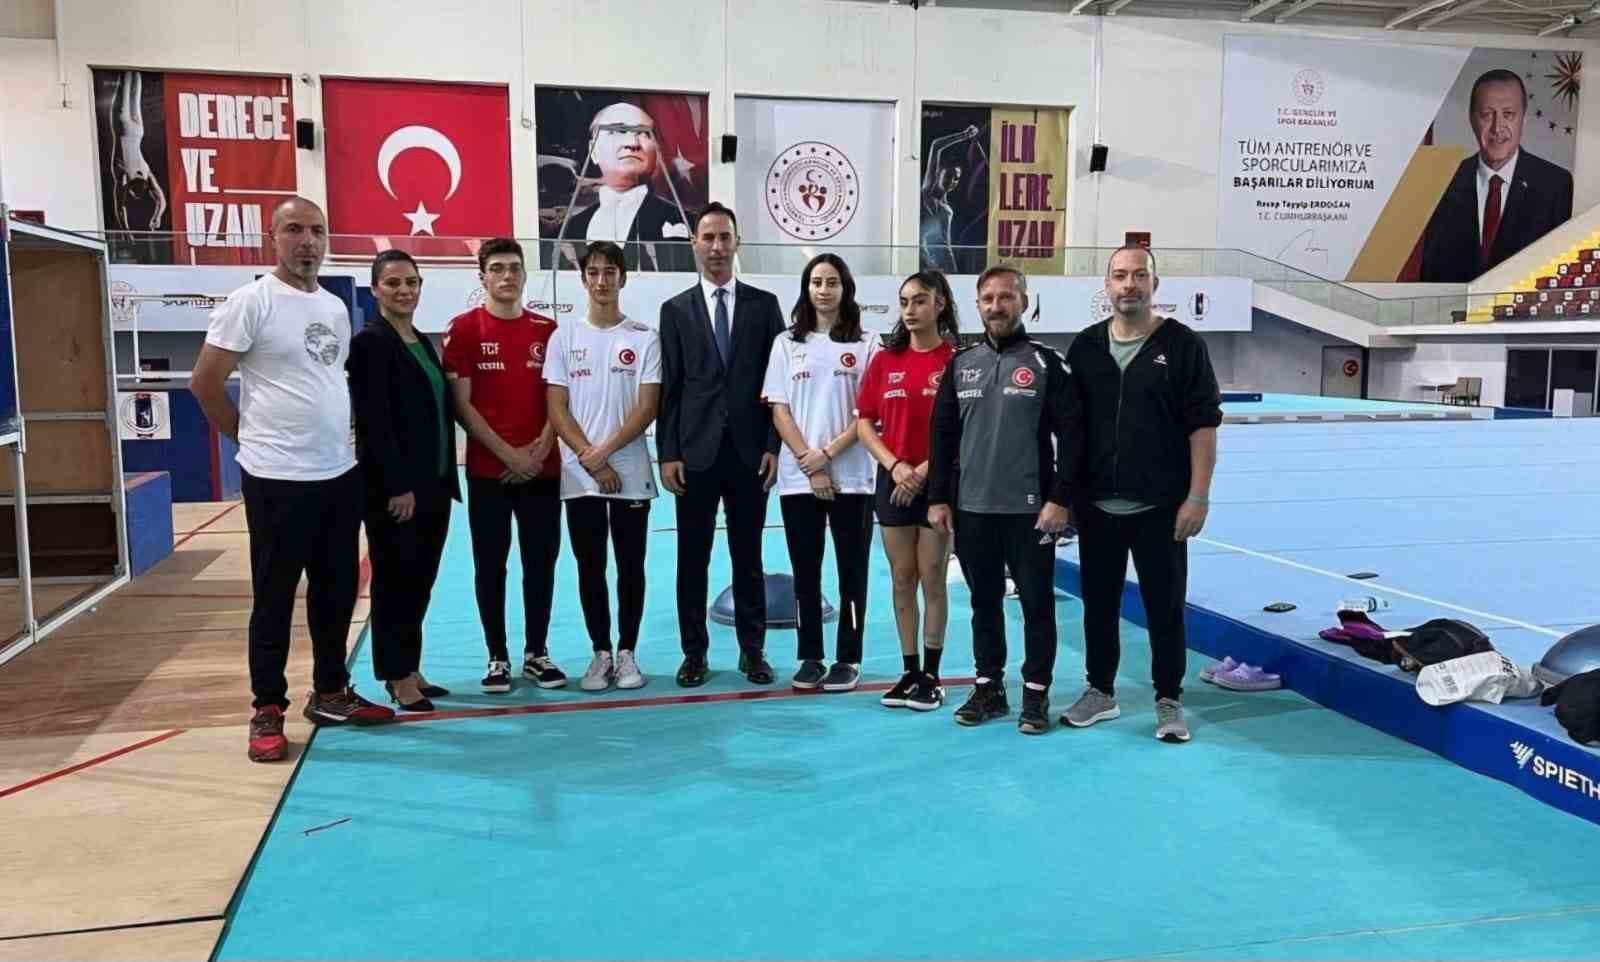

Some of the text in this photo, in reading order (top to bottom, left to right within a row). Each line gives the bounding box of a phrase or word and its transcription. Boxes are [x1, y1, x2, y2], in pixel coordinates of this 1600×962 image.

[178, 92, 291, 140] DERECE
[1000, 120, 1036, 163] İLK
[1238, 138, 1372, 157] TÜM ANTRENÖR VE
[180, 148, 220, 193] YE
[1233, 176, 1375, 190] BAŞARILAR DİLİYORUM
[1241, 157, 1367, 174] SPORCULARIMIZA
[1000, 172, 1053, 211] LERE
[1256, 200, 1351, 209] Recep Tayyip ERDOĞAN
[185, 202, 263, 248] UZAN
[998, 220, 1055, 258] UZAN
[480, 342, 499, 355] TCF
[961, 368, 982, 383] TCF
[1532, 755, 1600, 801] SPIETH
